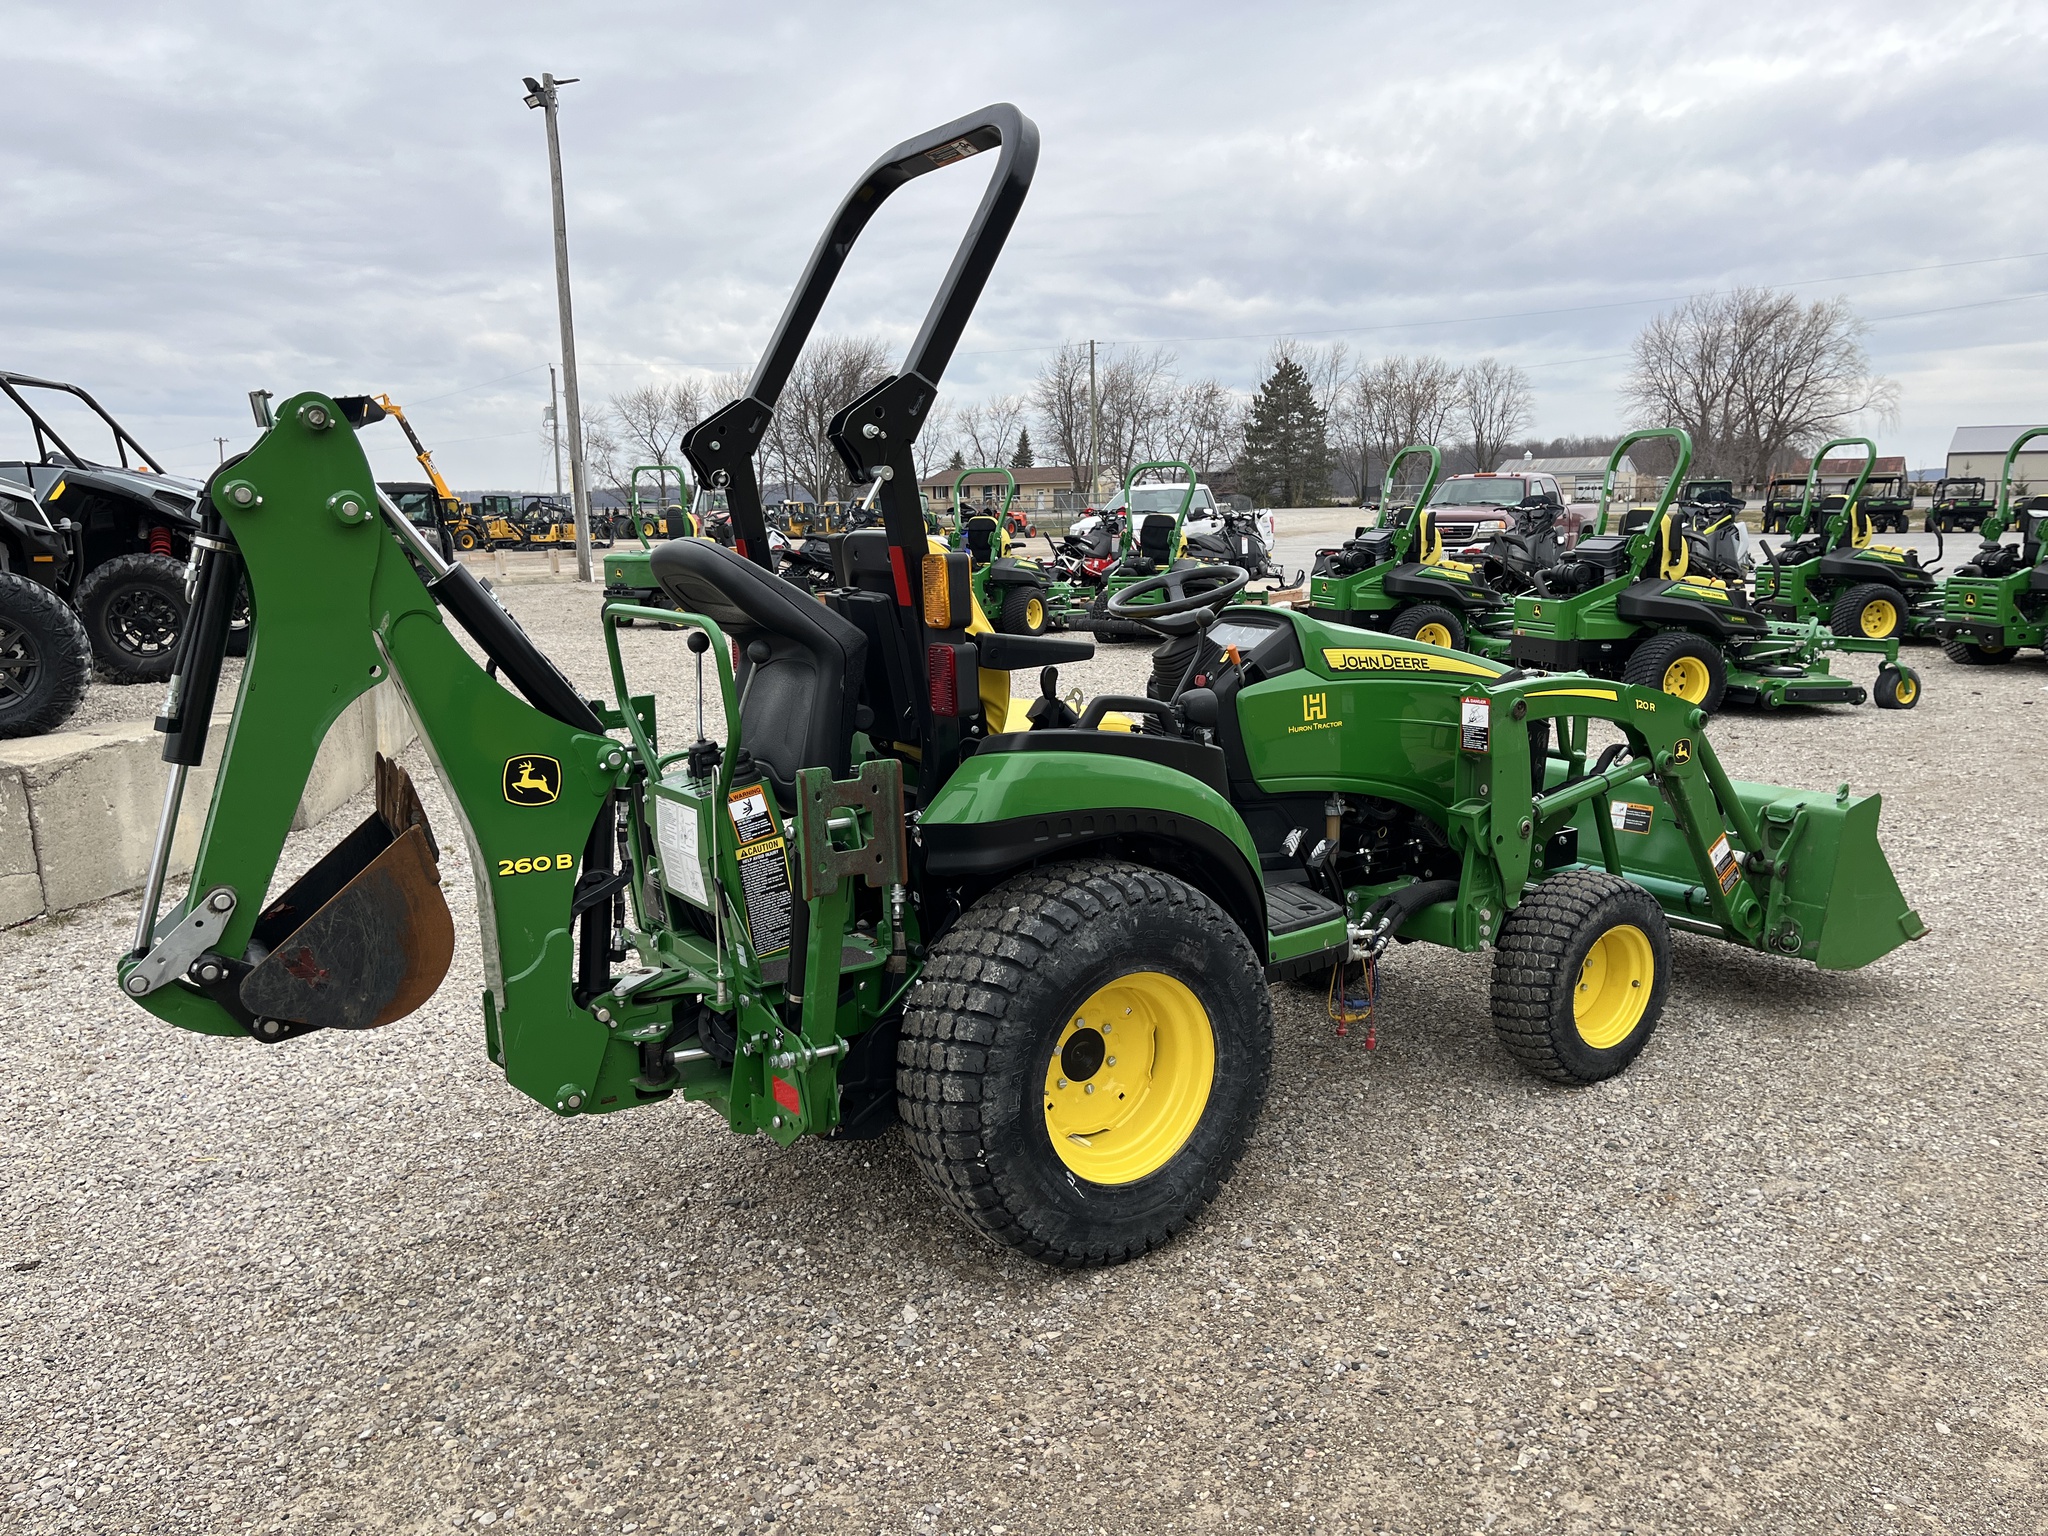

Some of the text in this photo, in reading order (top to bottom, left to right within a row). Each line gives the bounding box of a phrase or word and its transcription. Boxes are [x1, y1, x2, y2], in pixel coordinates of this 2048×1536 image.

[1339, 653, 1430, 670] JOHN DEERE
[1649, 702, 1656, 712] R
[1288, 720, 1343, 734] HURON TRACTOR
[733, 787, 761, 800] WARNING
[747, 839, 779, 856] CAUTION
[498, 852, 574, 877] 260 B
